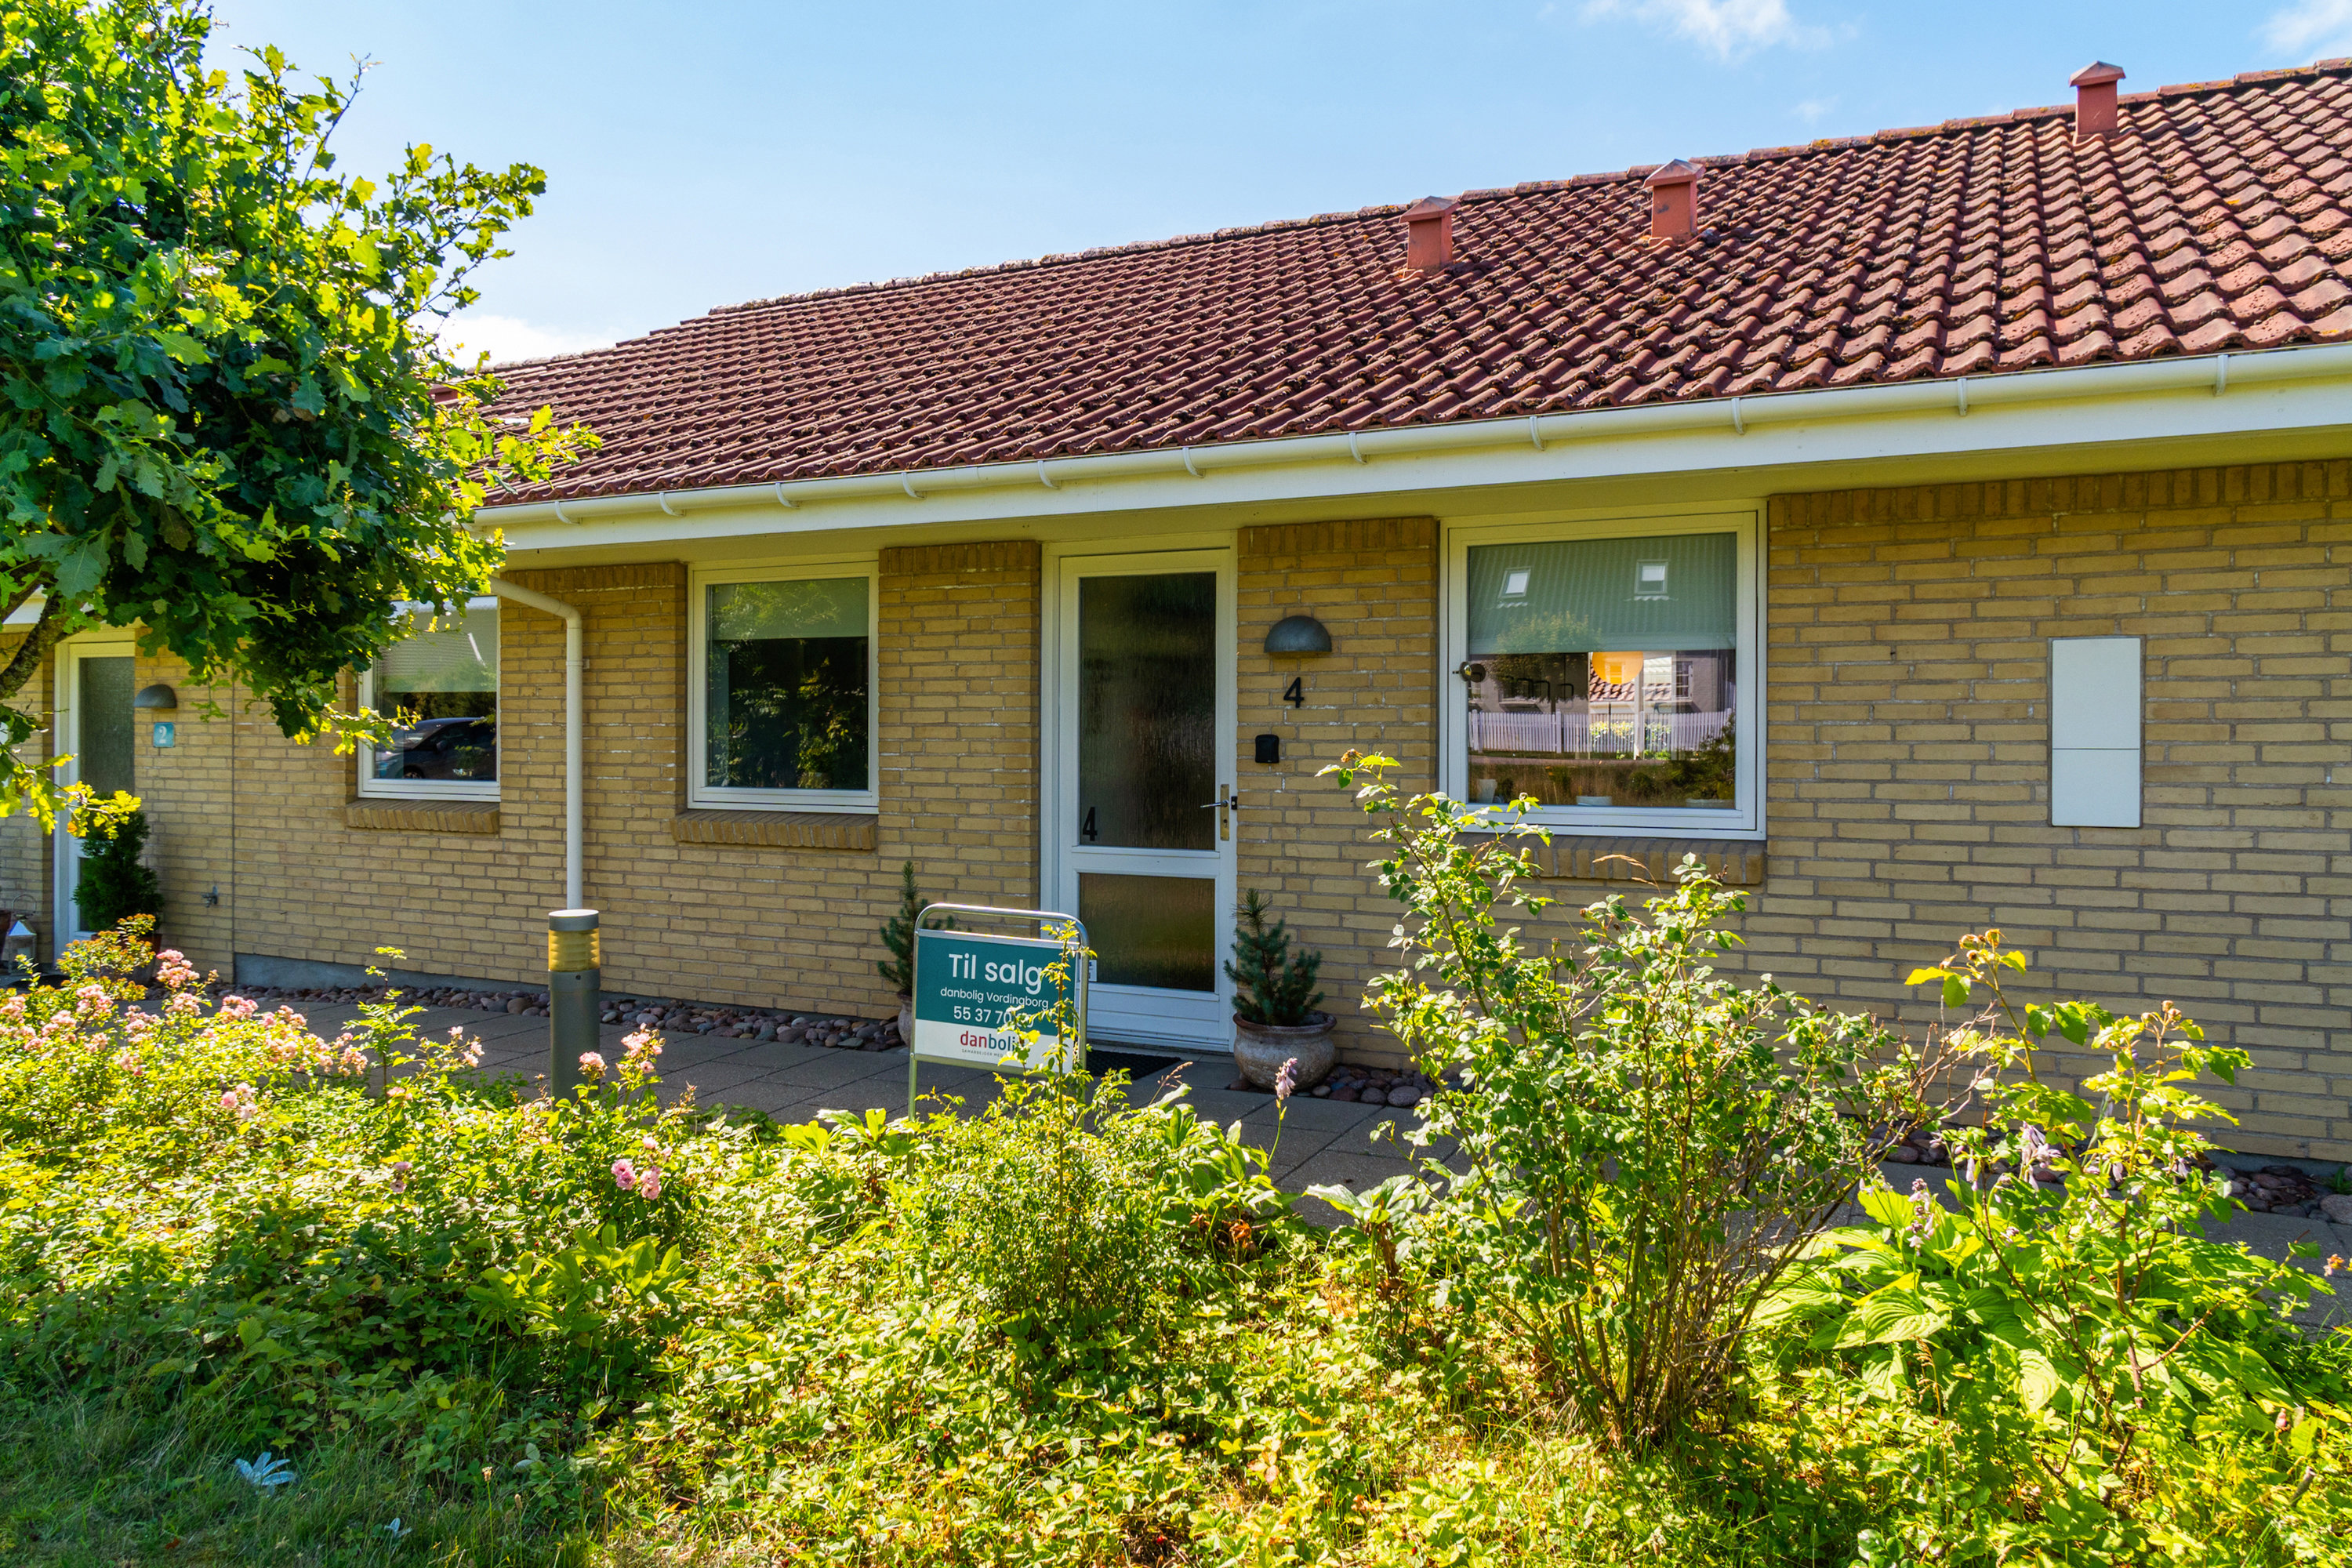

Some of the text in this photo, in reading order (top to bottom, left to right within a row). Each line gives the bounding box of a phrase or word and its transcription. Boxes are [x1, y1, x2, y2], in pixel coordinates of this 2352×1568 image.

[1283, 677, 1305, 708] 4
[159, 726, 167, 744] 2
[1083, 807, 1098, 841] 4
[949, 953, 1042, 995] Til salg
[941, 987, 1049, 1011] danbolig Vordingborg
[954, 1006, 971, 1021] 55
[975, 1008, 991, 1023] 37
[960, 1030, 1018, 1051] danboli
